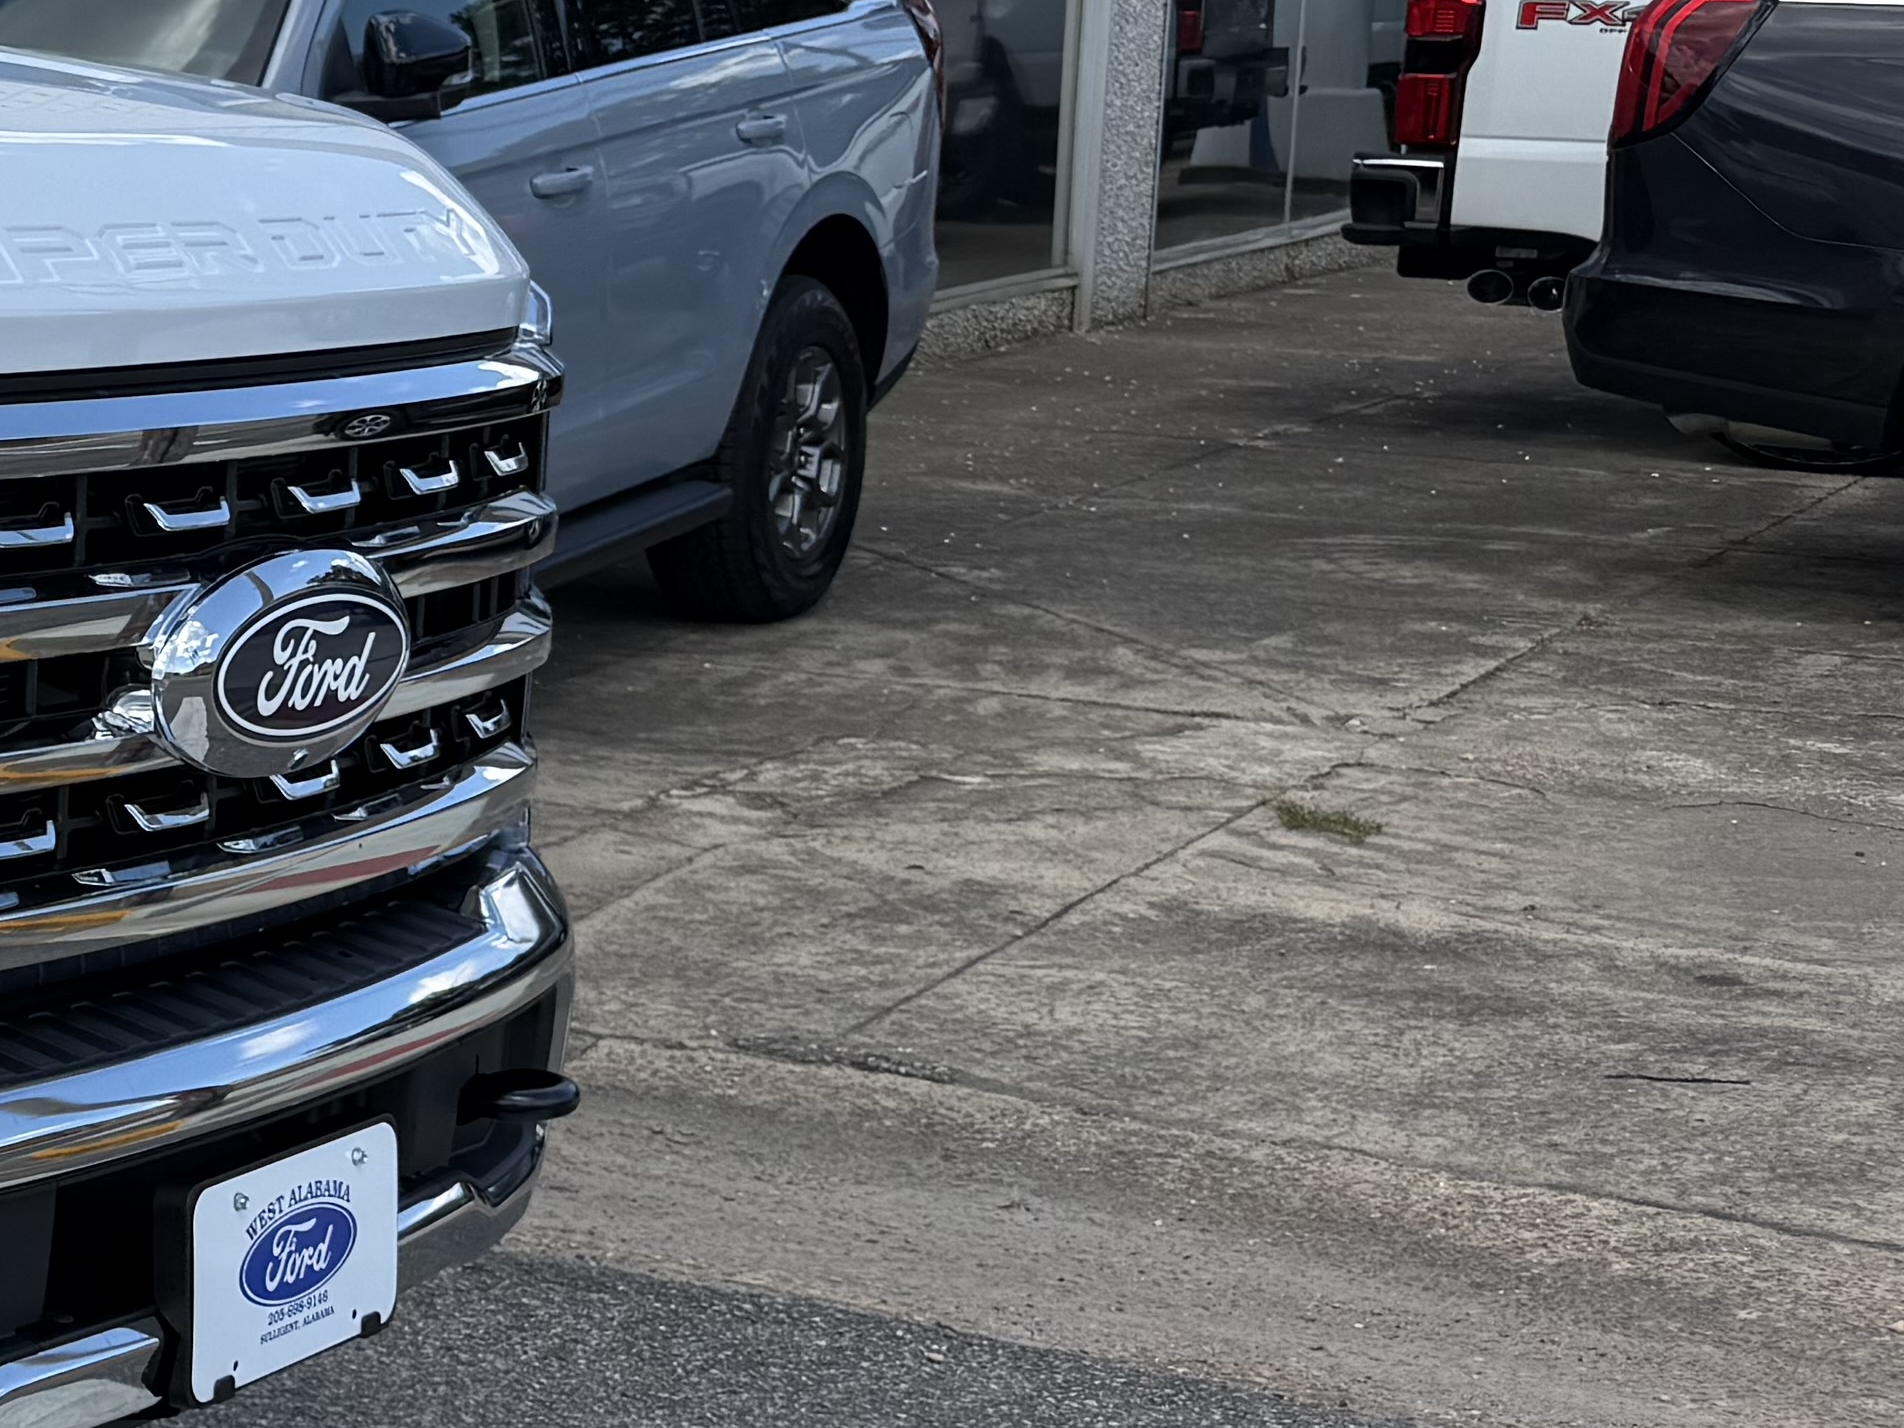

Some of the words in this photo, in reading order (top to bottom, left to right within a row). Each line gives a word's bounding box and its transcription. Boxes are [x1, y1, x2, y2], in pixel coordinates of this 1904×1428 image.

[257, 208, 476, 270] DUTY
[256, 615, 377, 718] Ford
[245, 1194, 285, 1241] WEST
[288, 1179, 351, 1208] ALABAMA
[265, 1218, 334, 1292] Ford
[302, 1305, 335, 1327] ALABAMA
